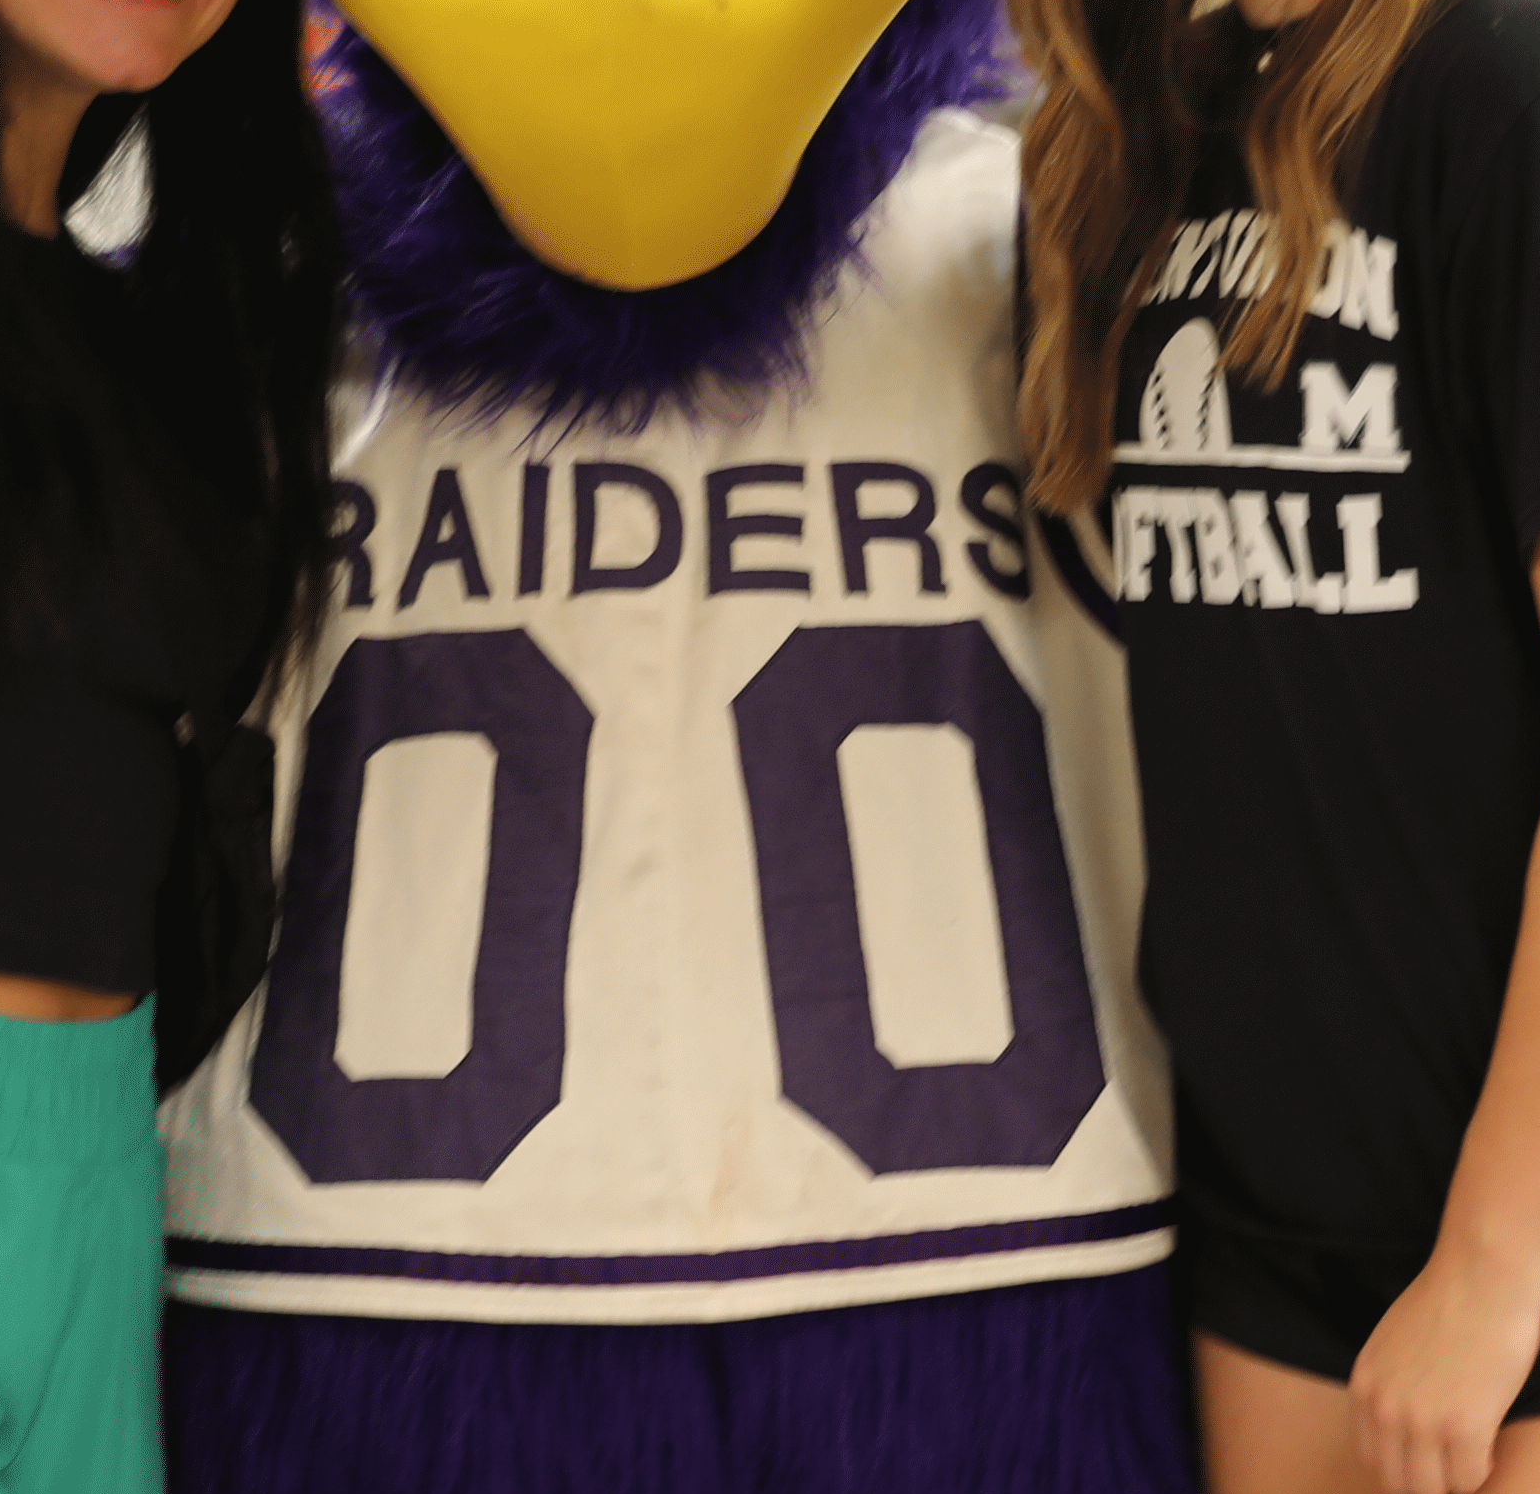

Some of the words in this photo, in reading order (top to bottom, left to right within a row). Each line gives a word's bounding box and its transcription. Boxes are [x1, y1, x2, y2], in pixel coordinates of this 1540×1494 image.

[1298, 361, 1402, 451] M
[326, 461, 1032, 611] RAIDERS
[1111, 483, 1420, 615] FTBALL
